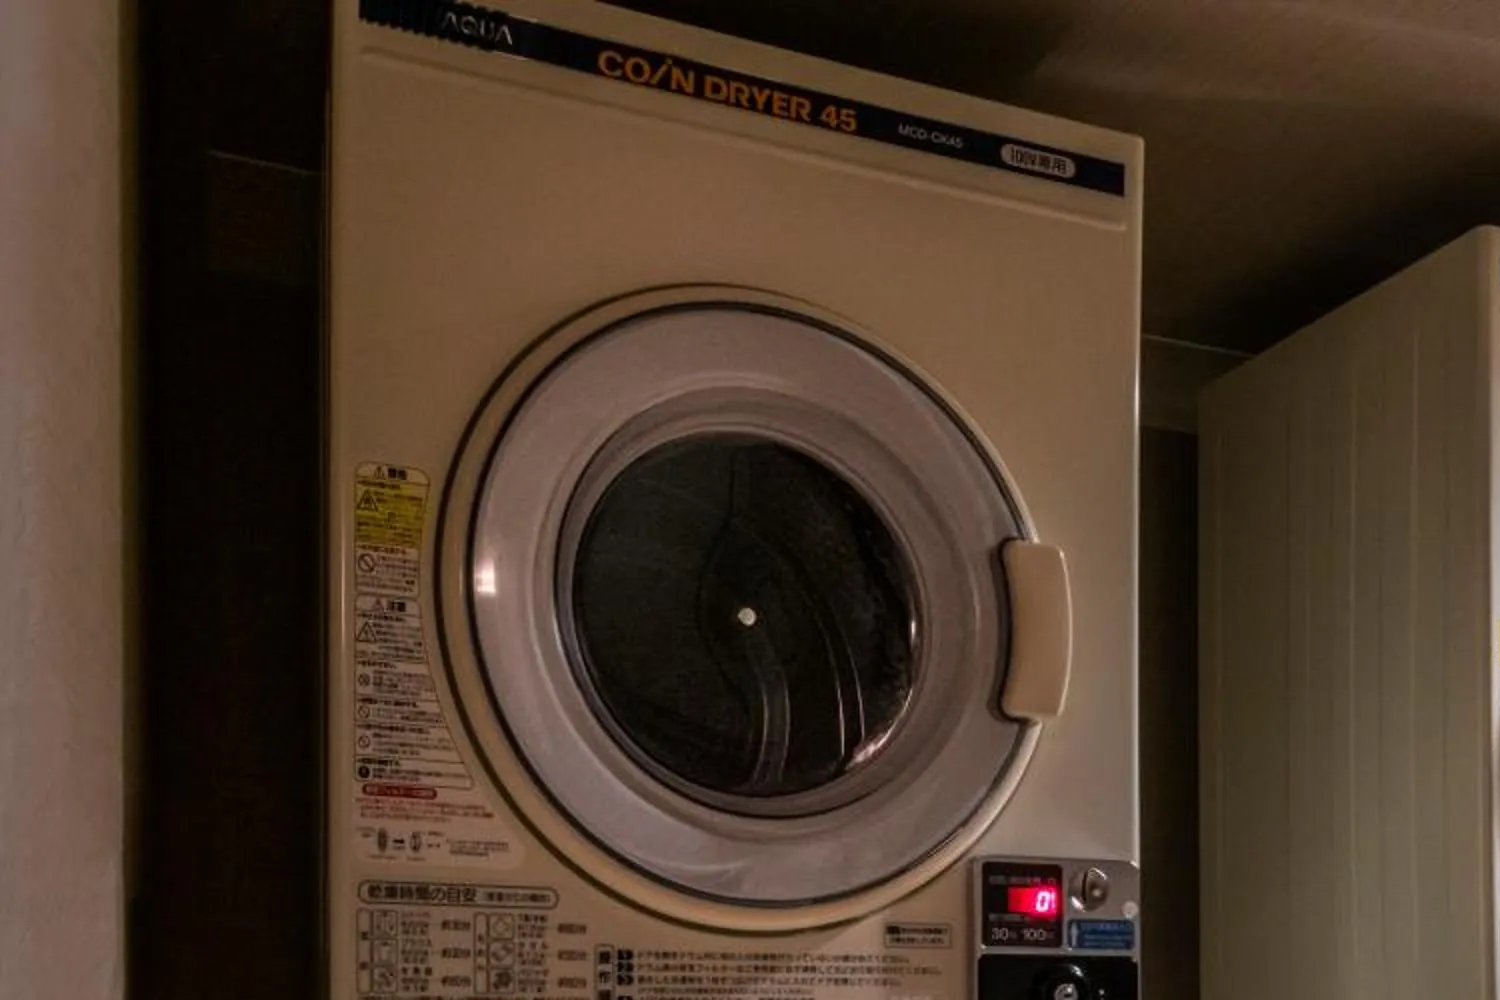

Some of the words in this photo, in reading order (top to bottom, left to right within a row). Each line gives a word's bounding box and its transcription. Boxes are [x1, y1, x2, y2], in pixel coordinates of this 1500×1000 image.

[438, 10, 513, 47] AQUA
[703, 73, 811, 124] DRYER
[820, 103, 858, 133] 45
